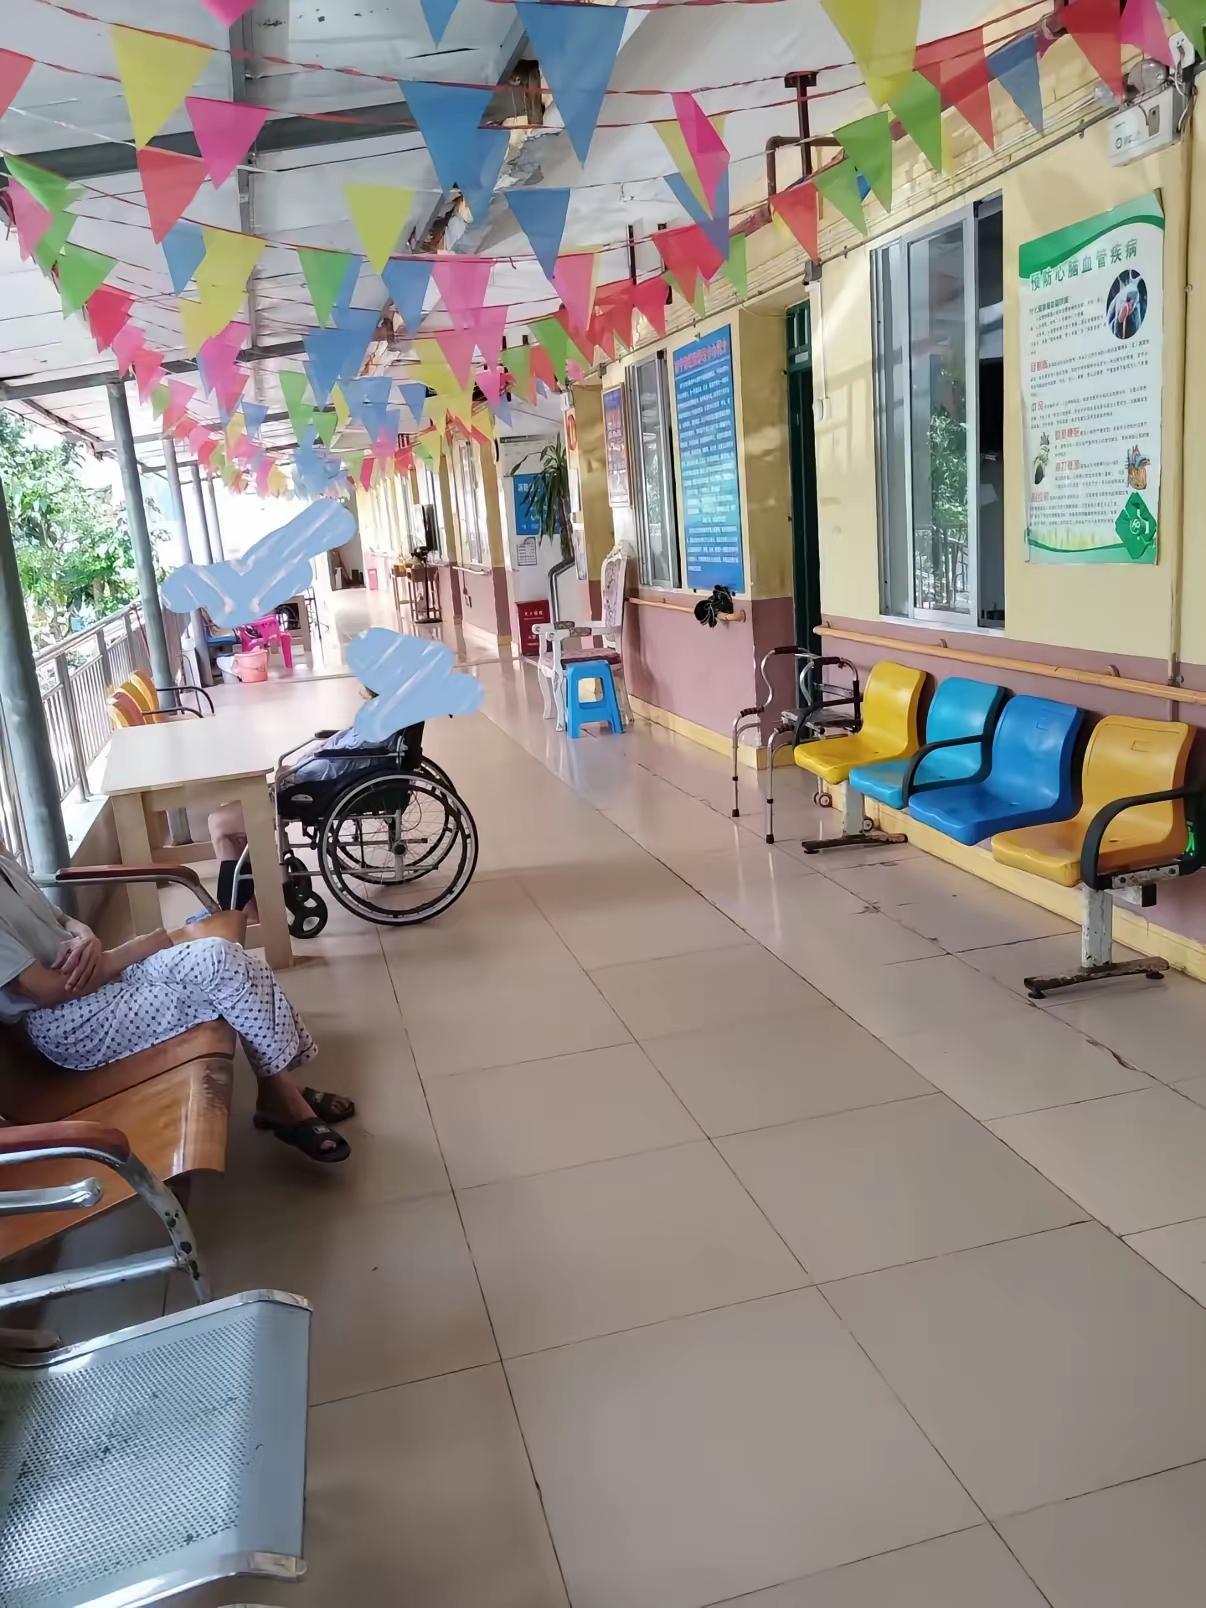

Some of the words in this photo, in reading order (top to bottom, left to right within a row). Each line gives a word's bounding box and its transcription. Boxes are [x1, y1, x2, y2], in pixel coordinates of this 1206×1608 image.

[1031, 238, 1137, 292] 预防心脑血管疾病
